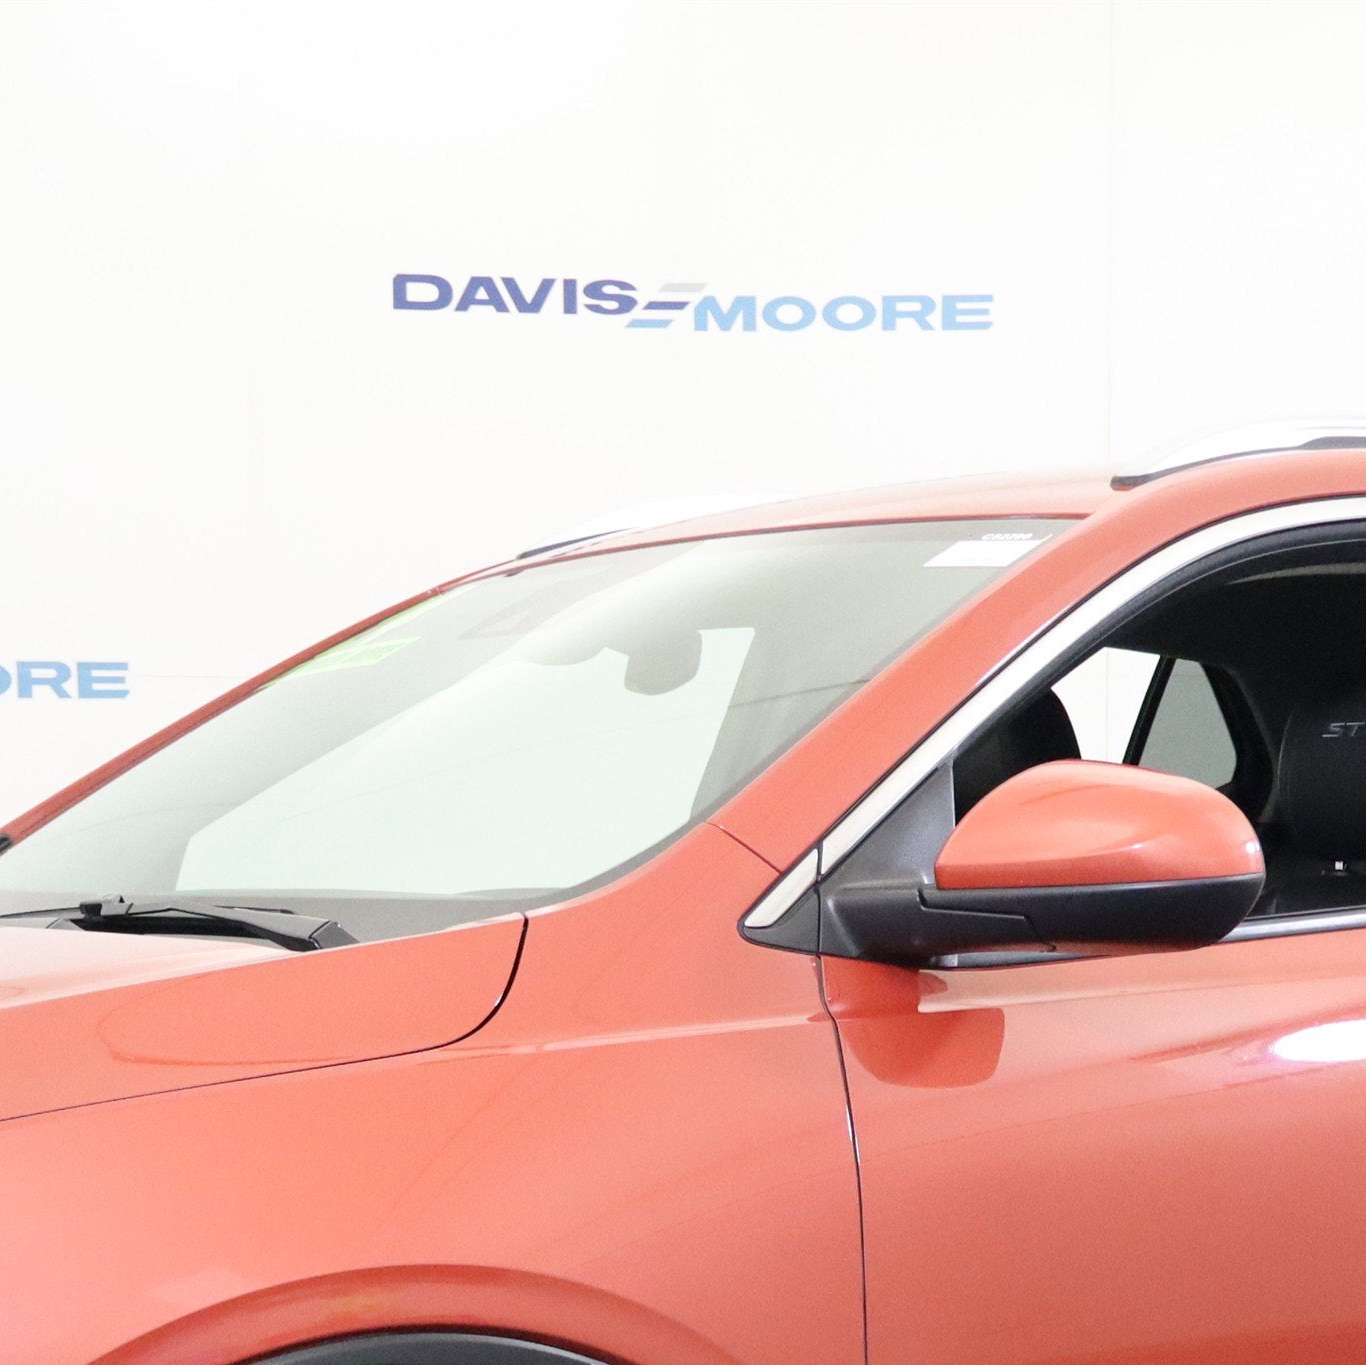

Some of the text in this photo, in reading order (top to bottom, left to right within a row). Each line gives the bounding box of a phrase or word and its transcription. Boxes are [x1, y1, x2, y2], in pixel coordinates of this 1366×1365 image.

[392, 273, 996, 334] DAVIS MOORE
[1321, 720, 1366, 740] ST
